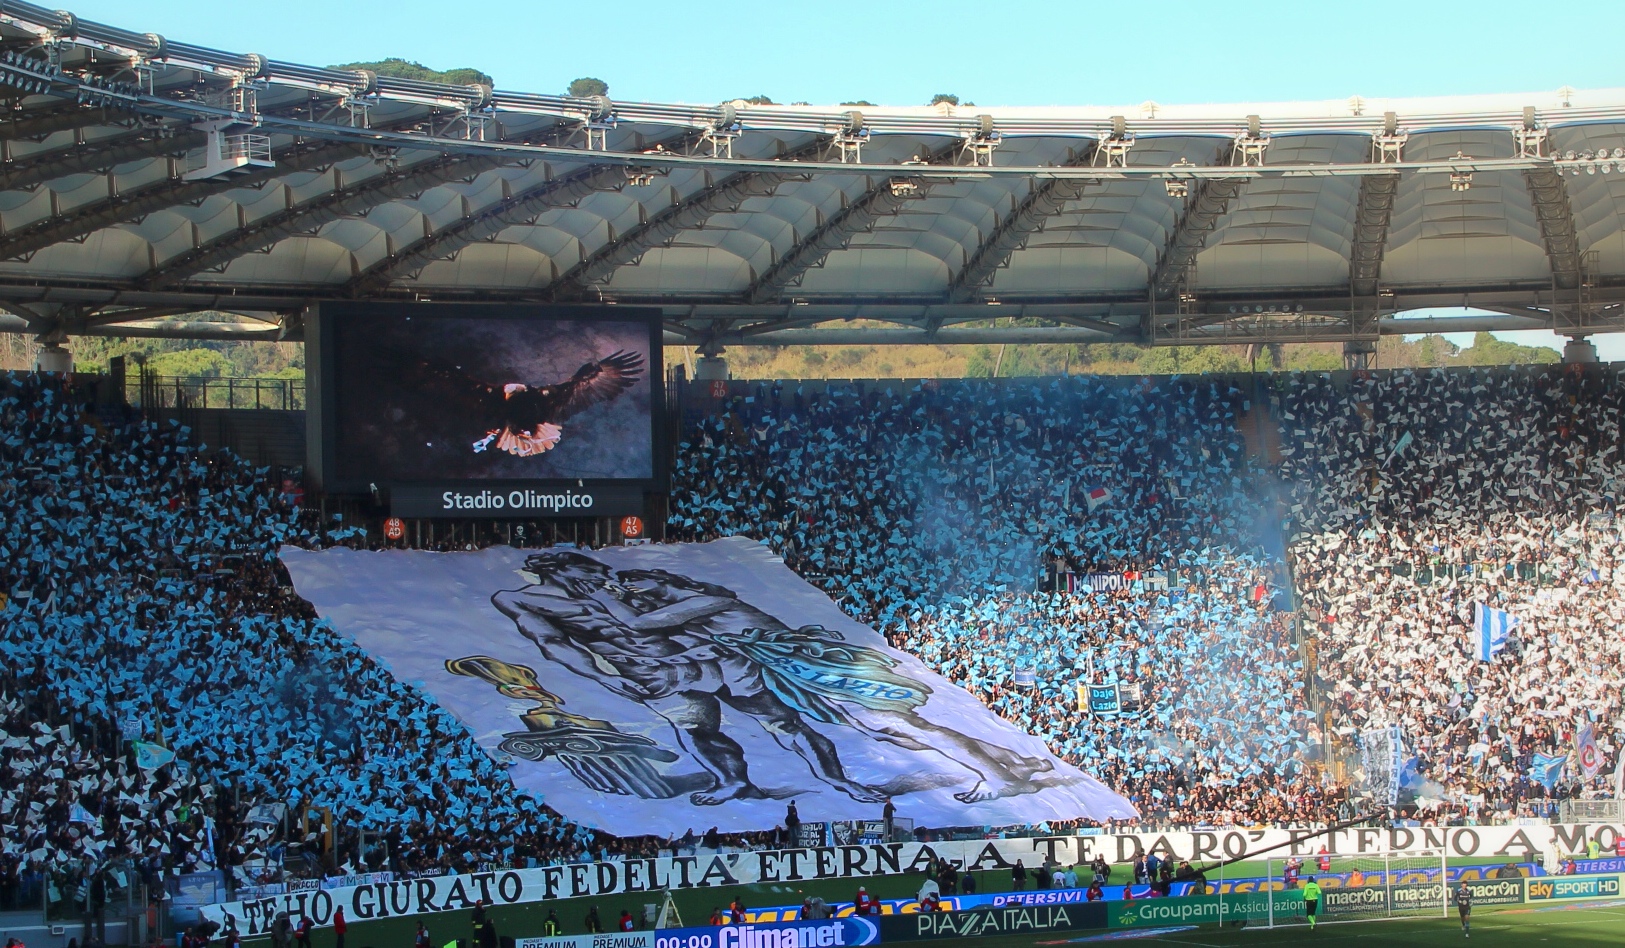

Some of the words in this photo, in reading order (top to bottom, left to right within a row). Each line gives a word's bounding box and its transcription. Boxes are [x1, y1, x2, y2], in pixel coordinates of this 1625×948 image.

[713, 380, 724, 389] 47
[713, 389, 726, 398] AD
[442, 490, 505, 509] Stadio
[508, 489, 593, 512] Olimpico
[388, 517, 400, 527] 48
[626, 516, 637, 526] 47
[388, 527, 401, 537] AD
[625, 525, 638, 535] AS
[807, 670, 913, 700] LAZIO
[1093, 688, 1115, 700] Daje
[1092, 700, 1118, 711] Lazio
[1563, 860, 1625, 872] ETERSI
[219, 904, 240, 937] A
[352, 871, 523, 919] GIURATO
[541, 853, 740, 899] FEDELTA'
[967, 841, 1015, 870] A
[1032, 836, 1098, 866] TE
[1115, 830, 1266, 863] DARO'
[1283, 826, 1480, 857] ETERNO
[1493, 824, 1625, 855] AMO
[1394, 884, 1453, 901] macron
[1529, 880, 1553, 898] sky
[1555, 881, 1597, 894] SPORT
[1598, 880, 1619, 893] HD
[993, 890, 1082, 907] DETERSIVI
[1326, 888, 1384, 905] macron
[1139, 900, 1229, 921] Groupama
[1233, 898, 1308, 914] Assicuazioni
[1003, 906, 1072, 931] ITALIA
[718, 921, 845, 948] Climanet
[593, 936, 647, 948] PREMIUM
